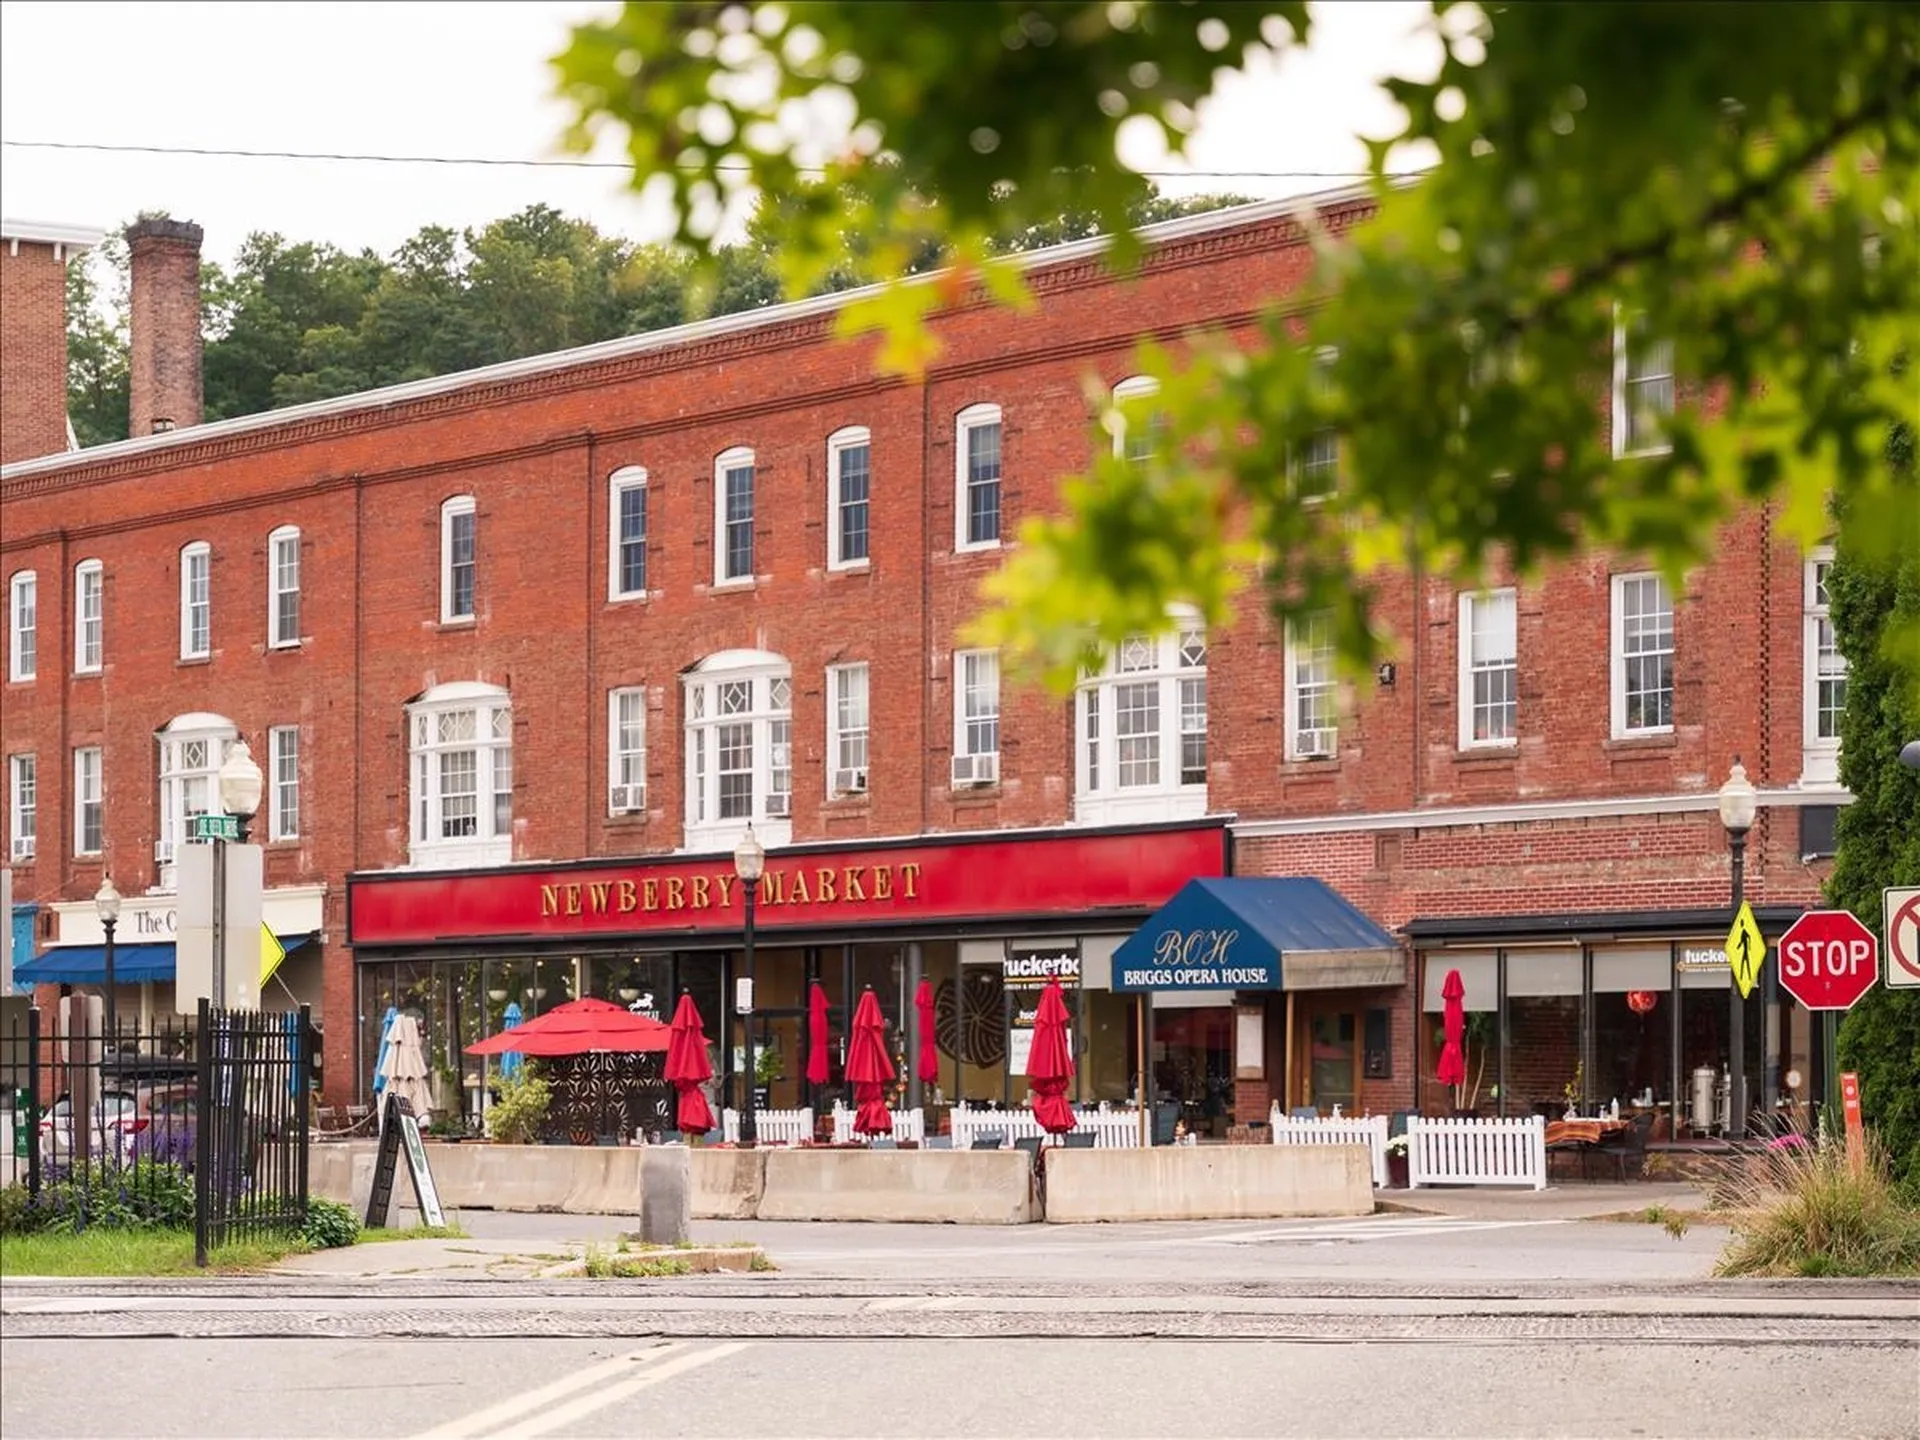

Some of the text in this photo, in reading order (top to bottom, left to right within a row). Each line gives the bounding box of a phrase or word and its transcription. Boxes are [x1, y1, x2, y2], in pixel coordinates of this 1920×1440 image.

[541, 862, 921, 917] NEWBERRY MARKET
[133, 910, 163, 934] The
[1153, 928, 1240, 966] BOH
[1685, 948, 1730, 964] tucke
[1785, 940, 1870, 977] STOP
[1123, 967, 1268, 986] BRIGGS OPERA HOUSE
